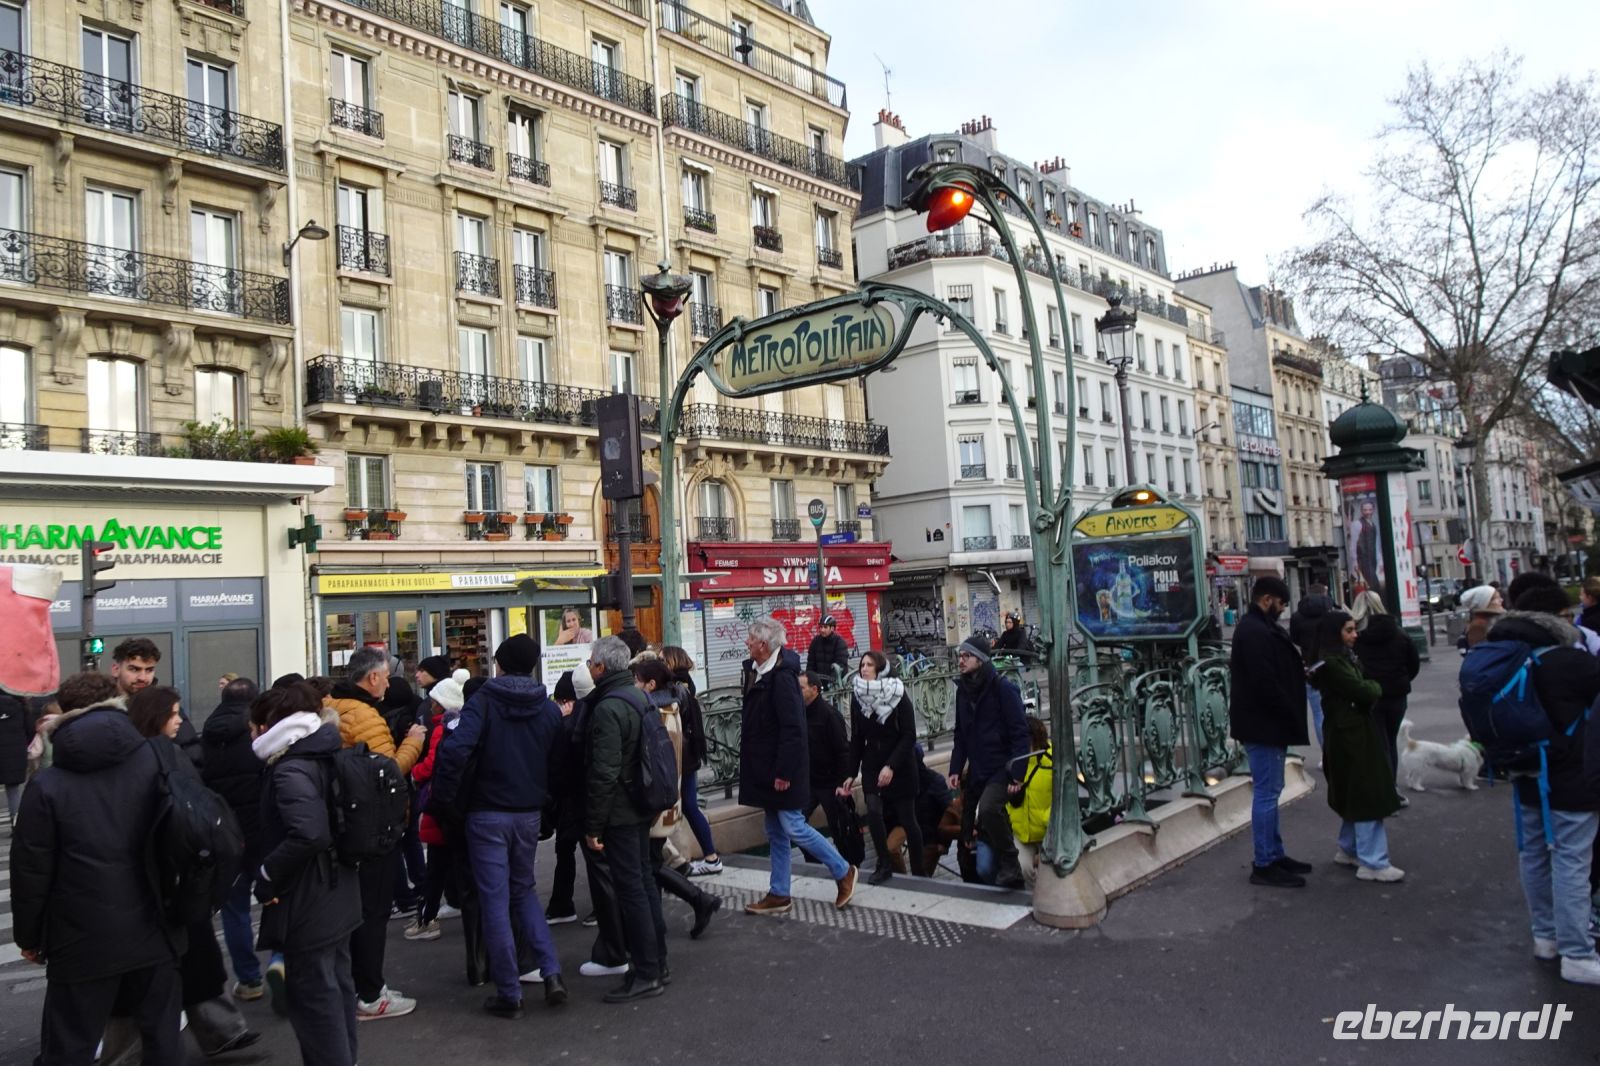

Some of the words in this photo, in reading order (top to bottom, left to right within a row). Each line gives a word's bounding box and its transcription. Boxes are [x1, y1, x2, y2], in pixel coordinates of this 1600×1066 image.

[731, 308, 886, 378] METROPOLITAIN
[810, 504, 823, 514] BUS
[1105, 515, 1157, 533] ANVERS
[0, 518, 222, 549] HARMAVANCE
[104, 553, 222, 565] PARAPHARMACIE
[715, 560, 738, 568] FEMMES
[1128, 554, 1178, 567] Poliakov
[397, 577, 412, 586] PRIX
[1153, 570, 1179, 583] POLIA
